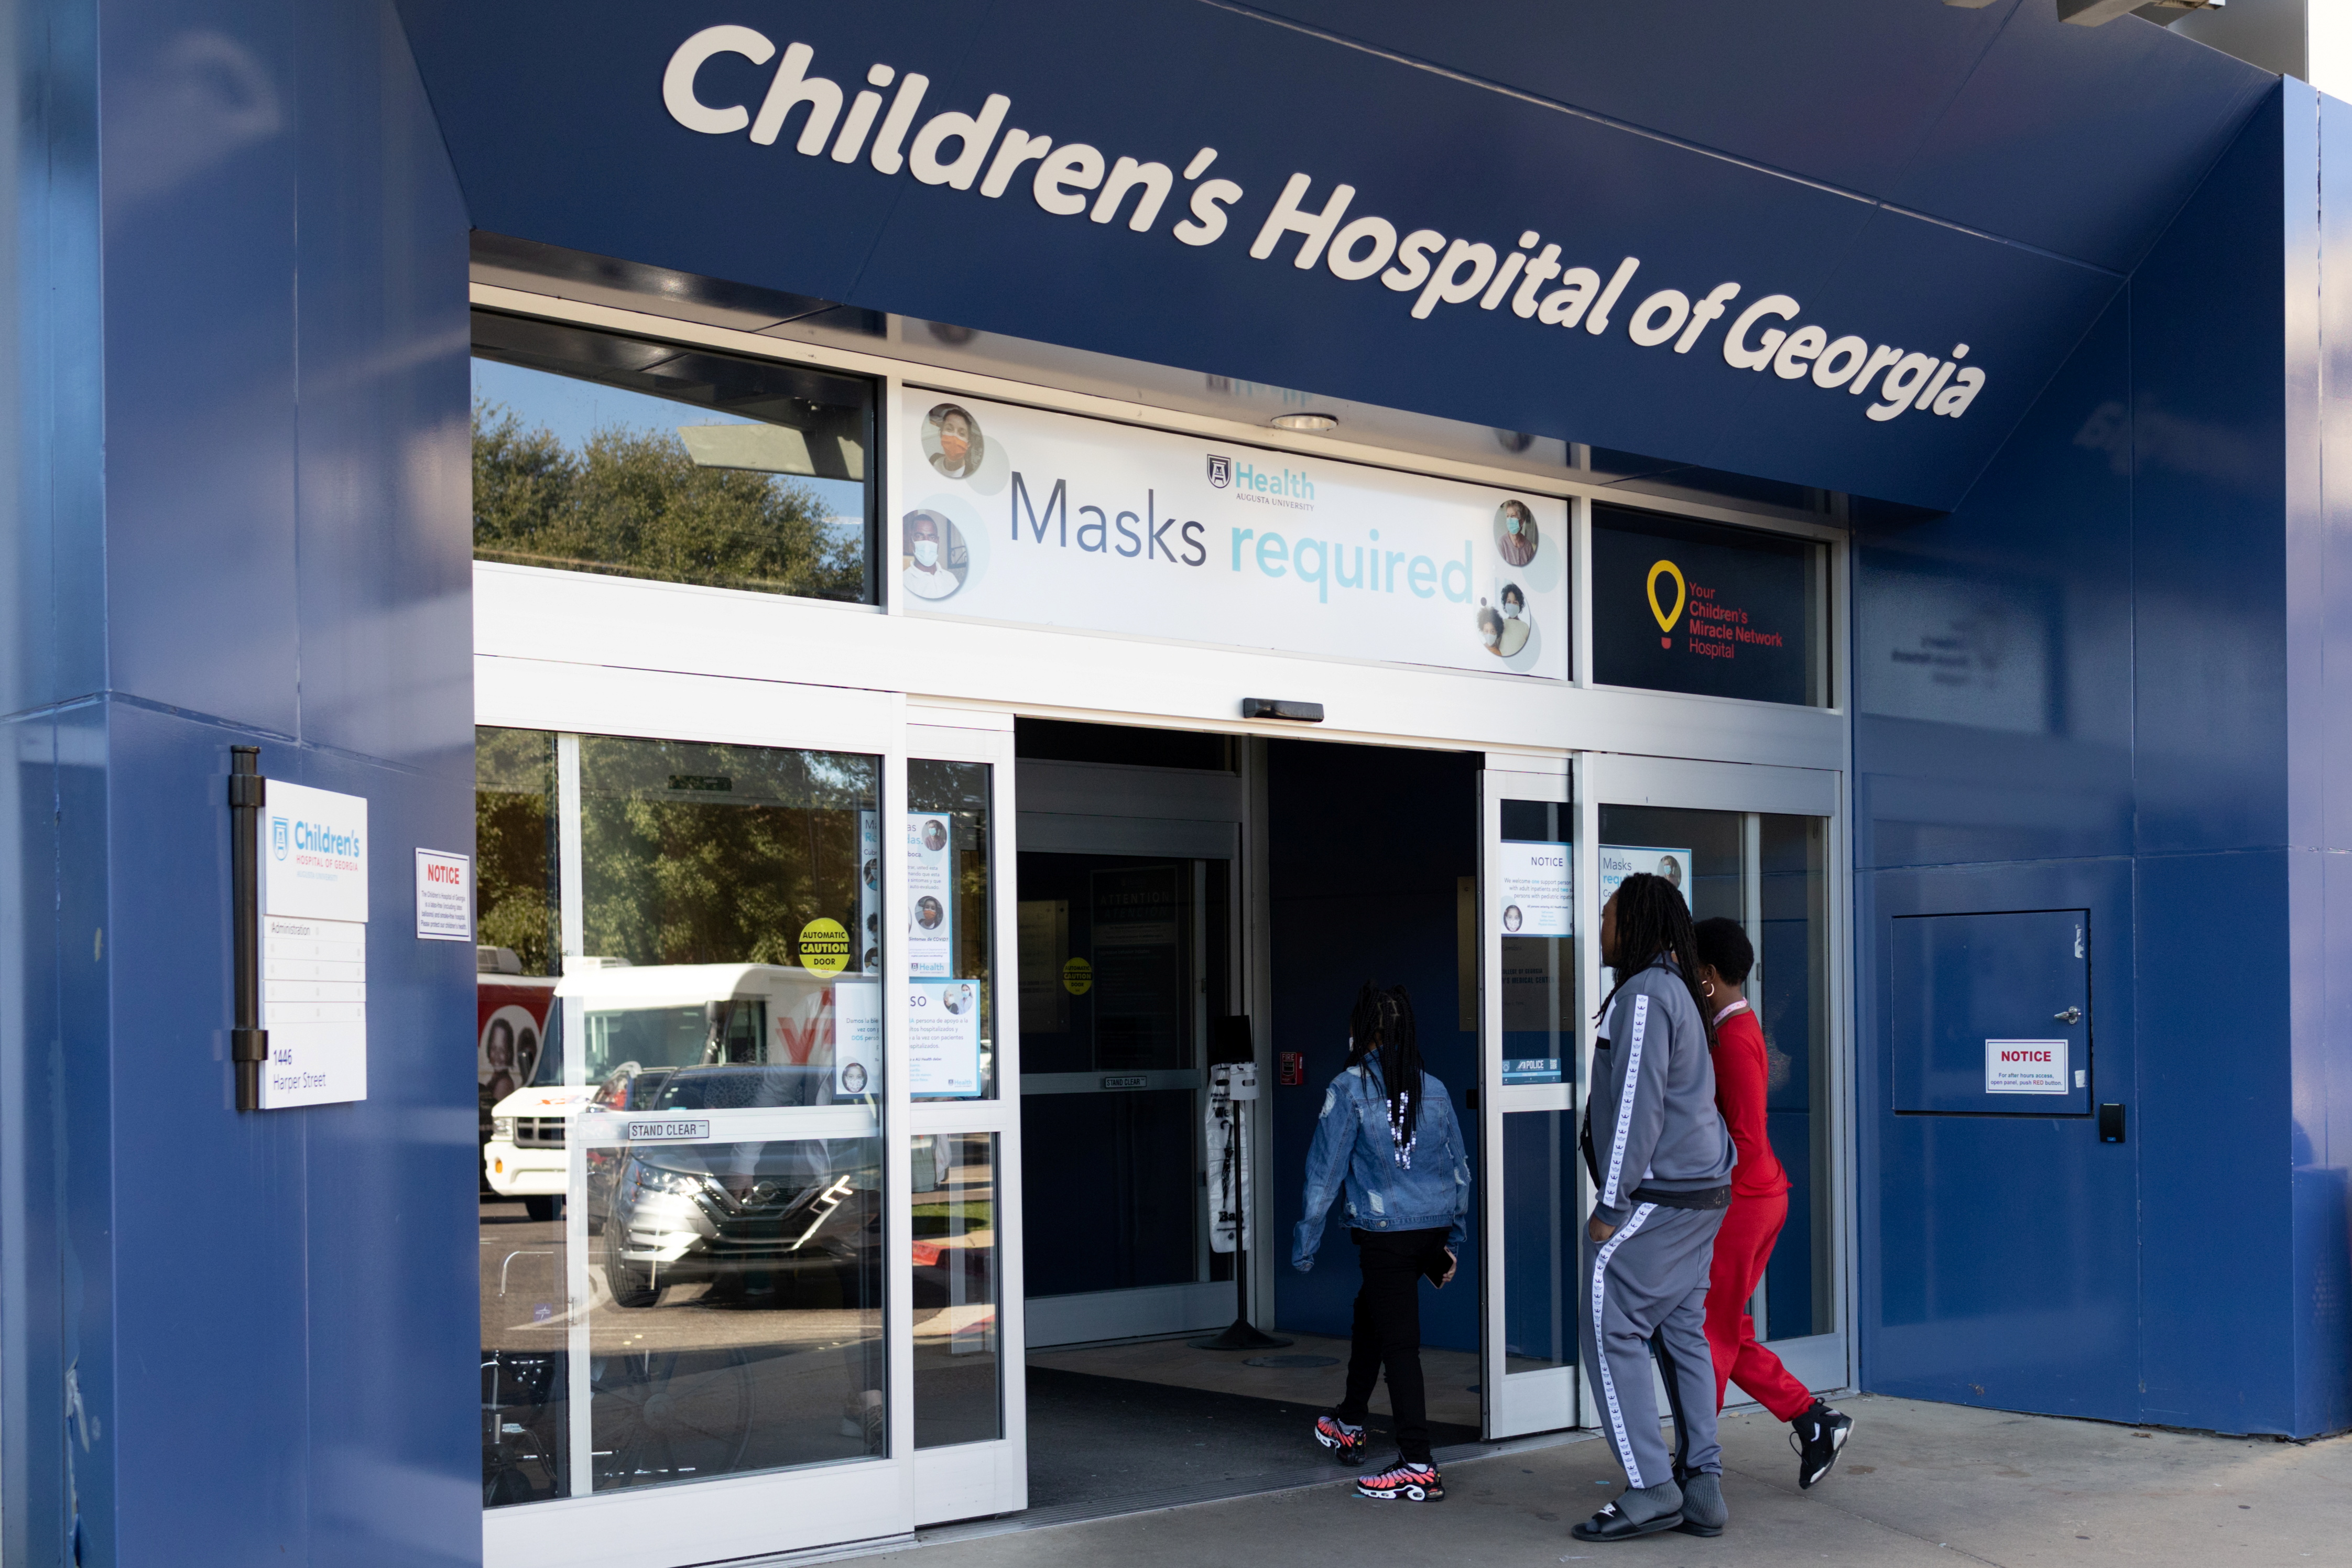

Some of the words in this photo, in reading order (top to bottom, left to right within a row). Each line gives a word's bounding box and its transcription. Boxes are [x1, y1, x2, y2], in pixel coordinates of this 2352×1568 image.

[662, 24, 1244, 246] Children's
[1249, 173, 1640, 335] Hospital
[1628, 282, 1741, 354] of
[1723, 294, 1986, 421] Georgia
[1235, 461, 1314, 500] Health
[1236, 493, 1270, 505] AUGUSTA
[1271, 498, 1315, 512] UNIVERSITY
[1010, 471, 1207, 567] Masks
[1231, 526, 1473, 603] required
[1689, 581, 1716, 599] Your
[1689, 600, 1748, 624] Children's
[1689, 618, 1733, 640] Miracle
[1735, 626, 1783, 647] Network
[1689, 637, 1735, 659] Hospital
[294, 820, 360, 858] Children's
[296, 854, 324, 867] HOSPITAL
[325, 858, 332, 868] OF
[334, 860, 358, 872] GEORGIA
[1531, 857, 1563, 867] NOTICE
[1603, 857, 1632, 871] Masks
[428, 864, 460, 885] NOTICE
[271, 921, 311, 935] Administration
[801, 943, 848, 953] CAUTION
[919, 962, 944, 971] Health
[274, 1049, 292, 1066] 1446
[1526, 1060, 1544, 1069] POLICE
[2001, 1051, 2052, 1062] NOTICE
[274, 1073, 301, 1094] Harper
[303, 1072, 326, 1088] Street
[632, 1125, 663, 1137] STAND
[667, 1124, 696, 1136] CLEAR
